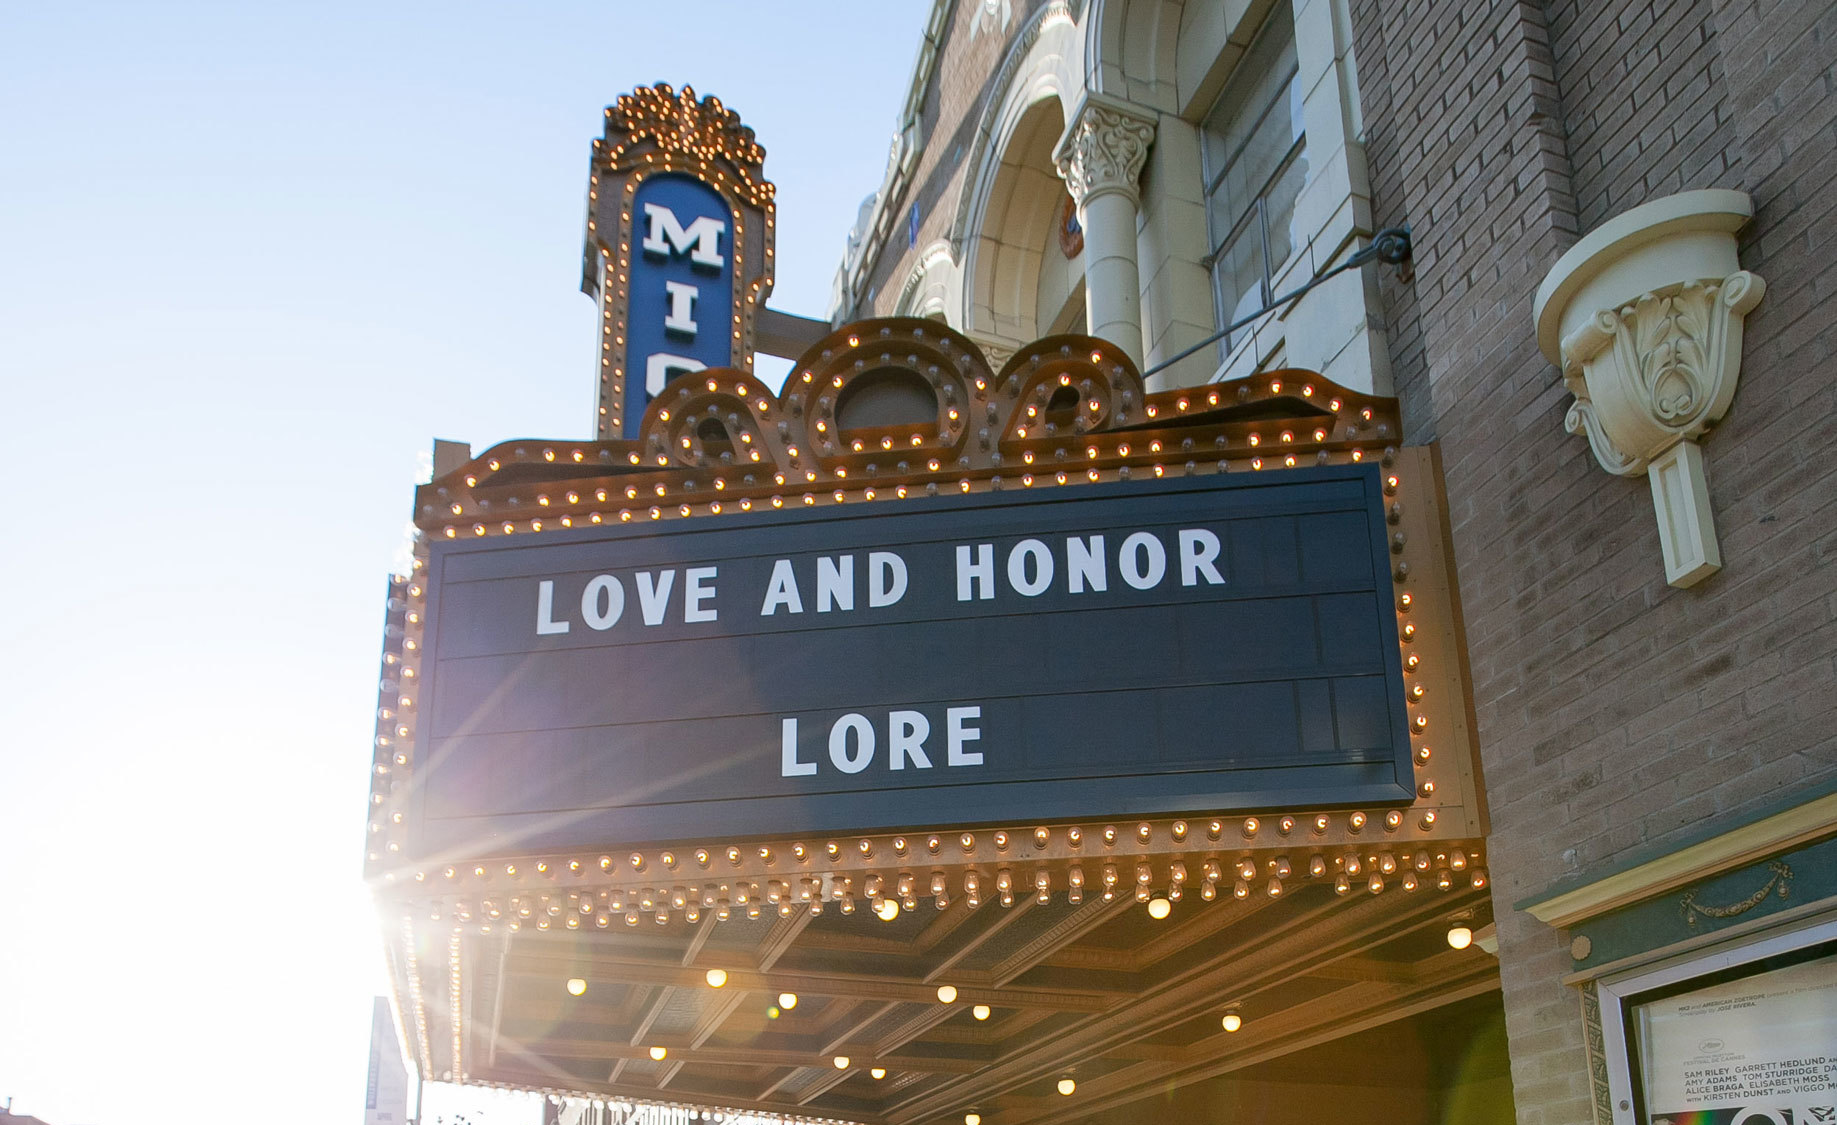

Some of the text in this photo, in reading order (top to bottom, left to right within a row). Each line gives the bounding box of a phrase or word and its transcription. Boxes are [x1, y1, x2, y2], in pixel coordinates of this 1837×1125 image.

[536, 529, 1225, 635] LOVE AND HONOR
[781, 706, 984, 777] LORE
[1684, 1070, 1703, 1079] SAM
[1704, 1067, 1730, 1077] RILEY
[1734, 1062, 1777, 1074] GARRETT
[1780, 1056, 1826, 1069] HEDLUND
[1685, 1078, 1704, 1087] AMY
[1706, 1074, 1738, 1085] ADAMS
[1742, 1072, 1762, 1081] TOM
[1764, 1066, 1819, 1079] STURRIDGE
[1685, 1073, 1830, 1095] ALICE BRAGA ELISABETH MOSS
[1703, 1091, 1741, 1102] KIRSTEN
[1743, 1088, 1774, 1098] DUNST
[1793, 1083, 1825, 1093] VIGGO
